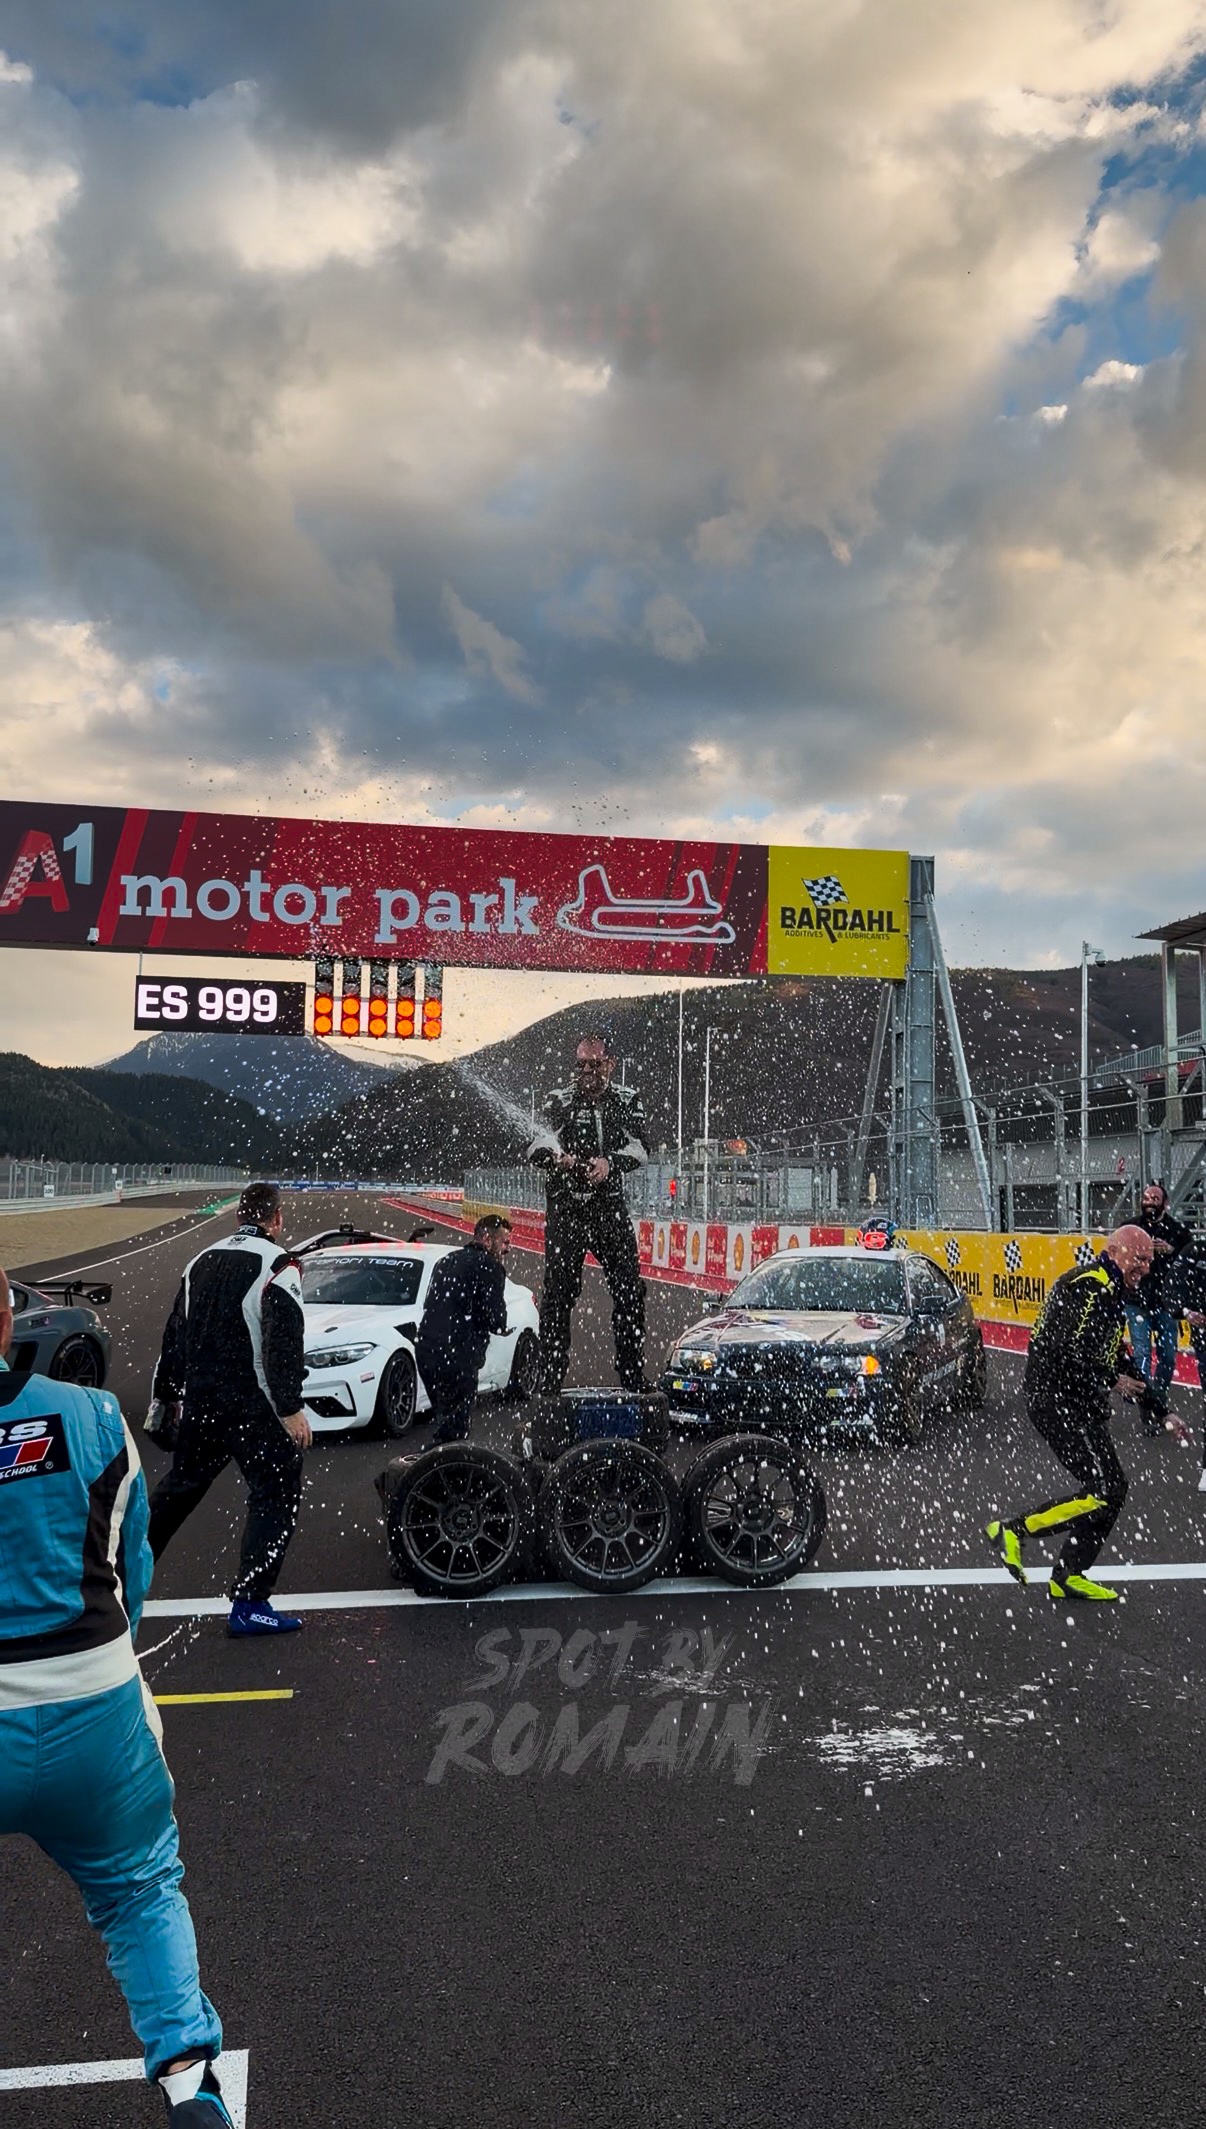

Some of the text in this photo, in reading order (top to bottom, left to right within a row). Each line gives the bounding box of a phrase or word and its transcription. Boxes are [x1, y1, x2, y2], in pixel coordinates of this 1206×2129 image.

[0, 822, 540, 944] A1 motor park
[780, 906, 900, 944] BARDAHL
[784, 930, 890, 941] ADDITIVES & LUBRICANTS
[137, 984, 278, 1023] ES 999
